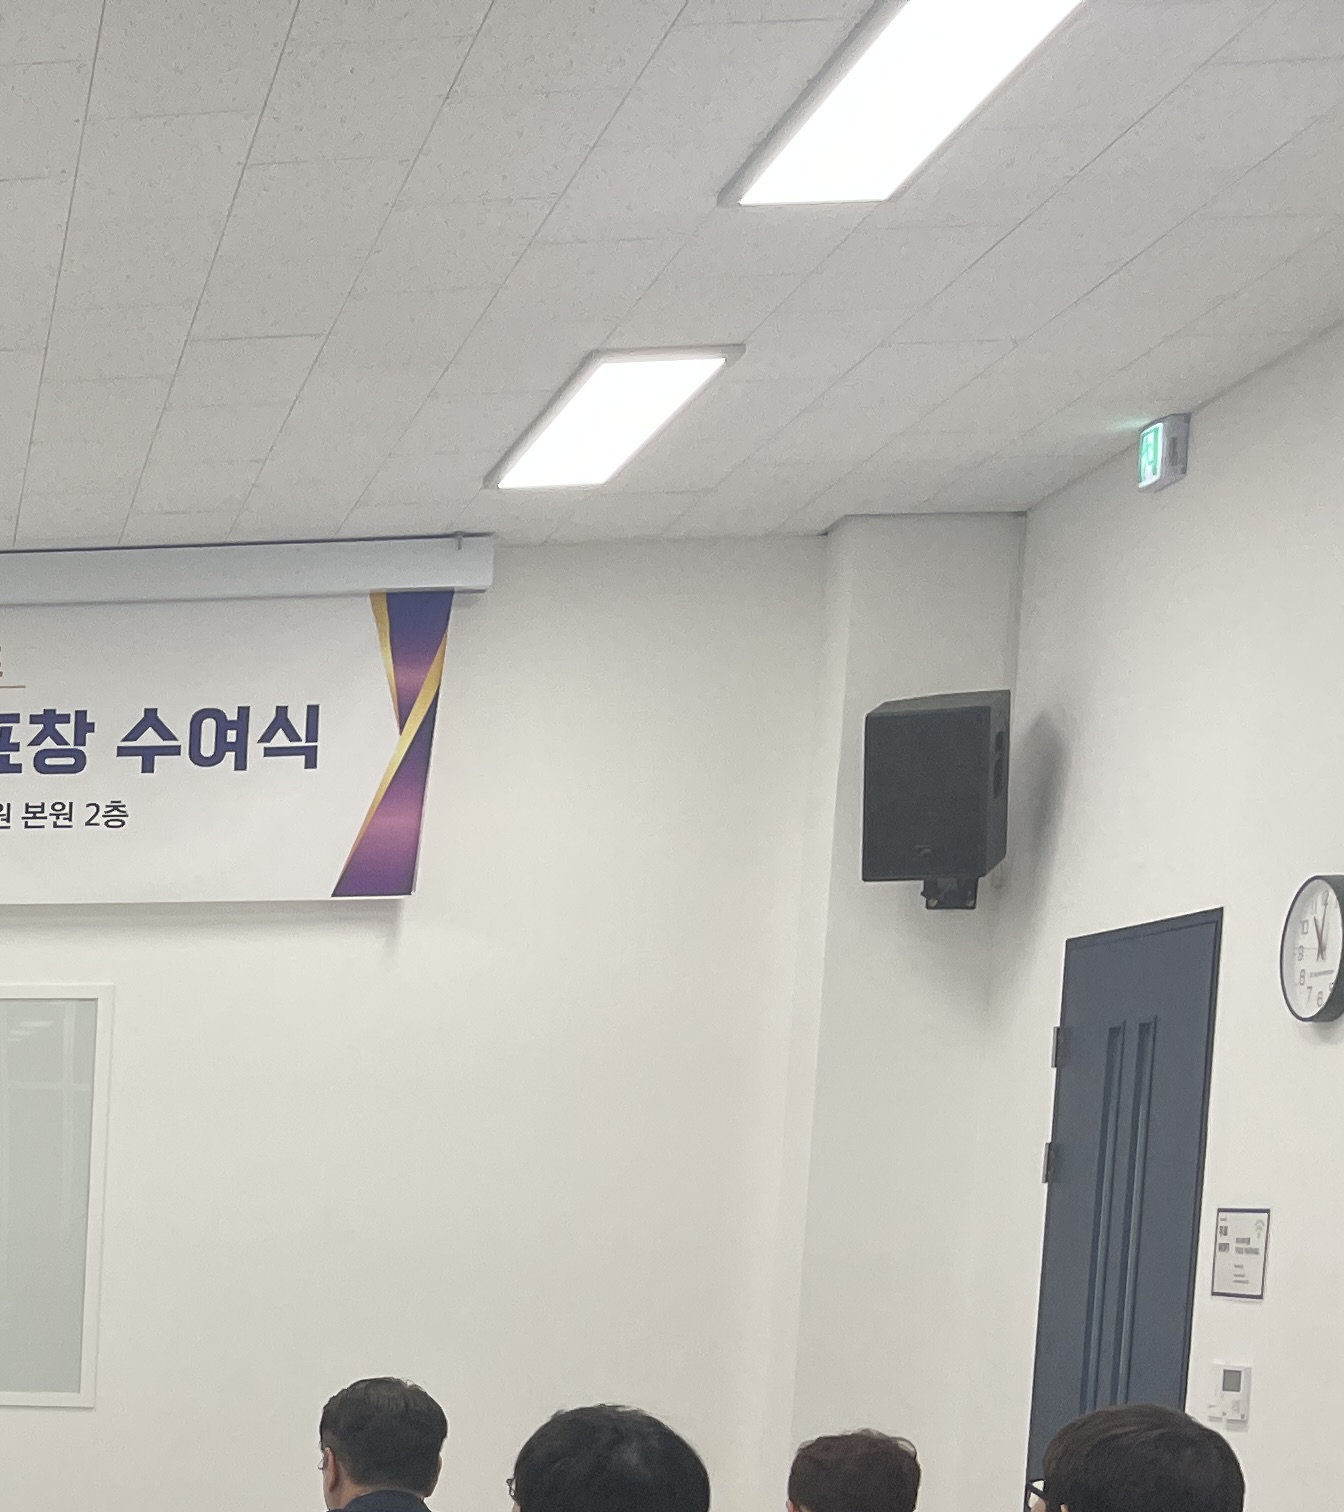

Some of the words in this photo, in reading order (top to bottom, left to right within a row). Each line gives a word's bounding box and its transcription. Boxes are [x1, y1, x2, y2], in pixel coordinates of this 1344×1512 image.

[117, 705, 319, 773] 수여식
[22, 802, 73, 828] 본원
[85, 801, 128, 828] 2층
